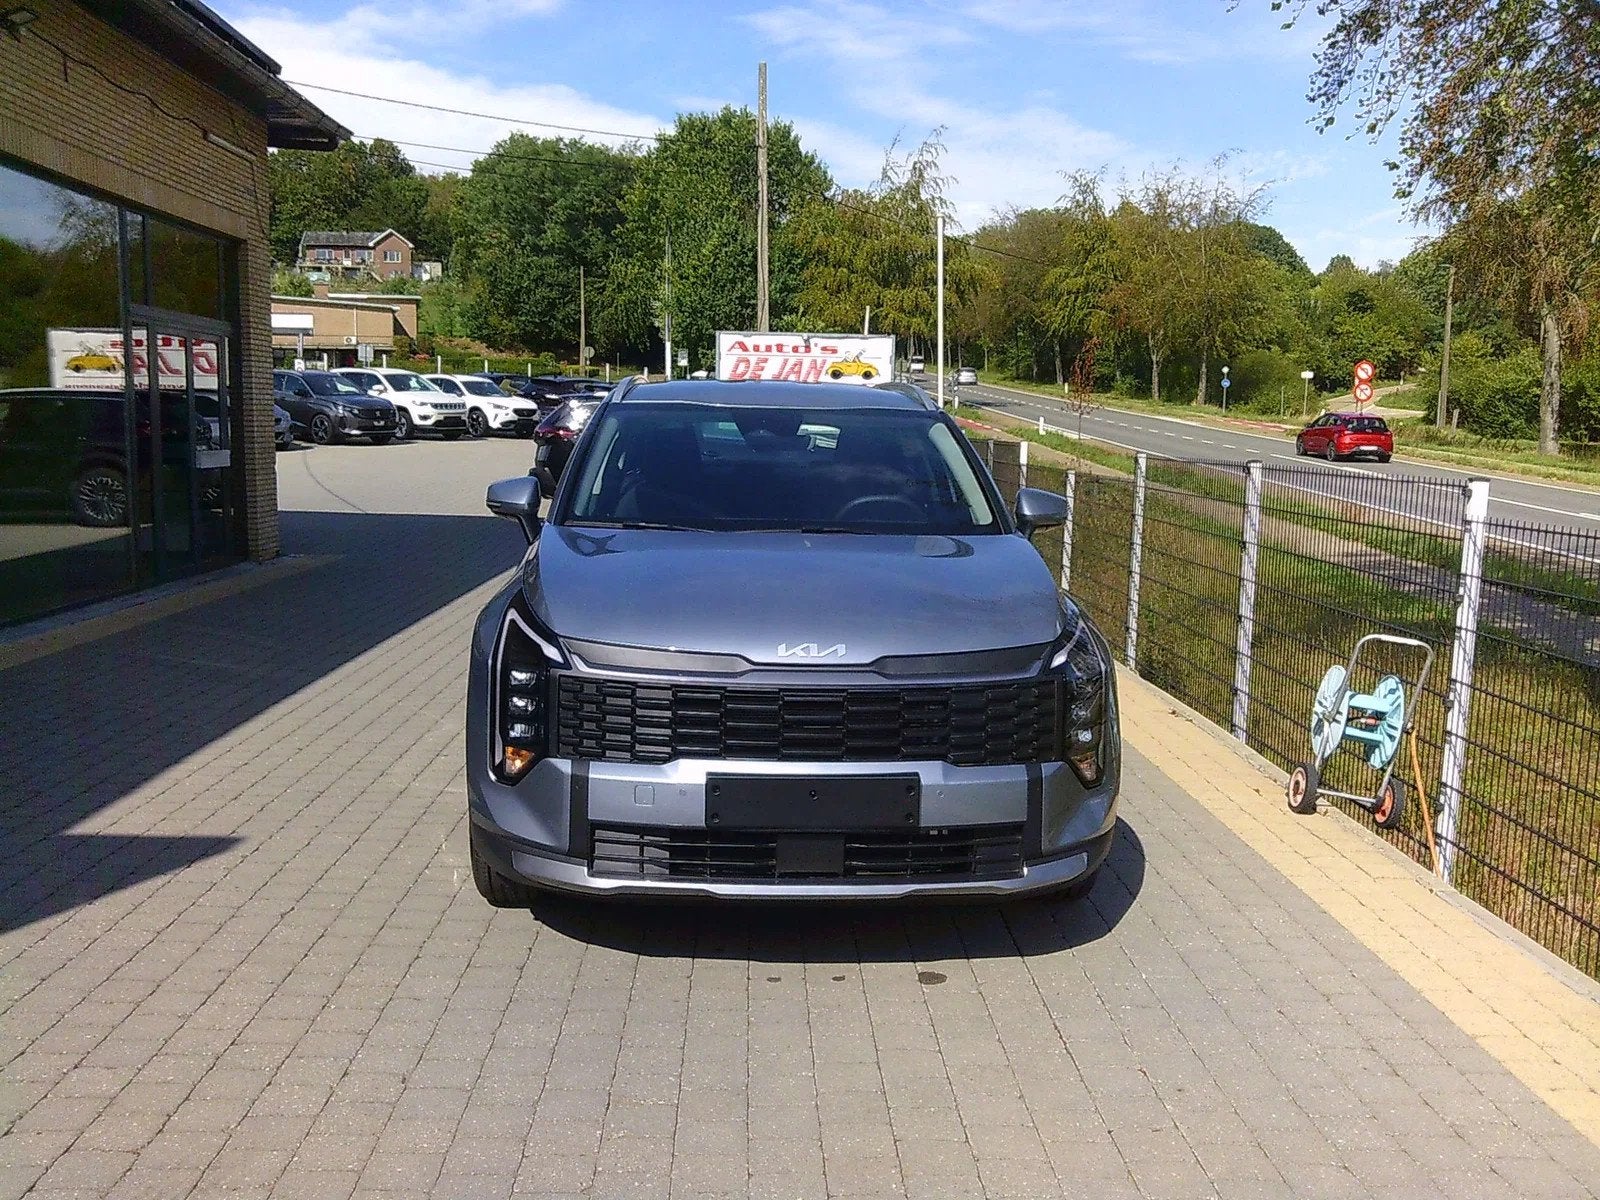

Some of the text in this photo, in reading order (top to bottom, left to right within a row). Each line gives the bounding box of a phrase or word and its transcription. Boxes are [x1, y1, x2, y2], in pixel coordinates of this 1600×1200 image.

[727, 340, 839, 355] Auto's
[729, 356, 827, 383] DE JAN
[777, 642, 847, 658] KIA
